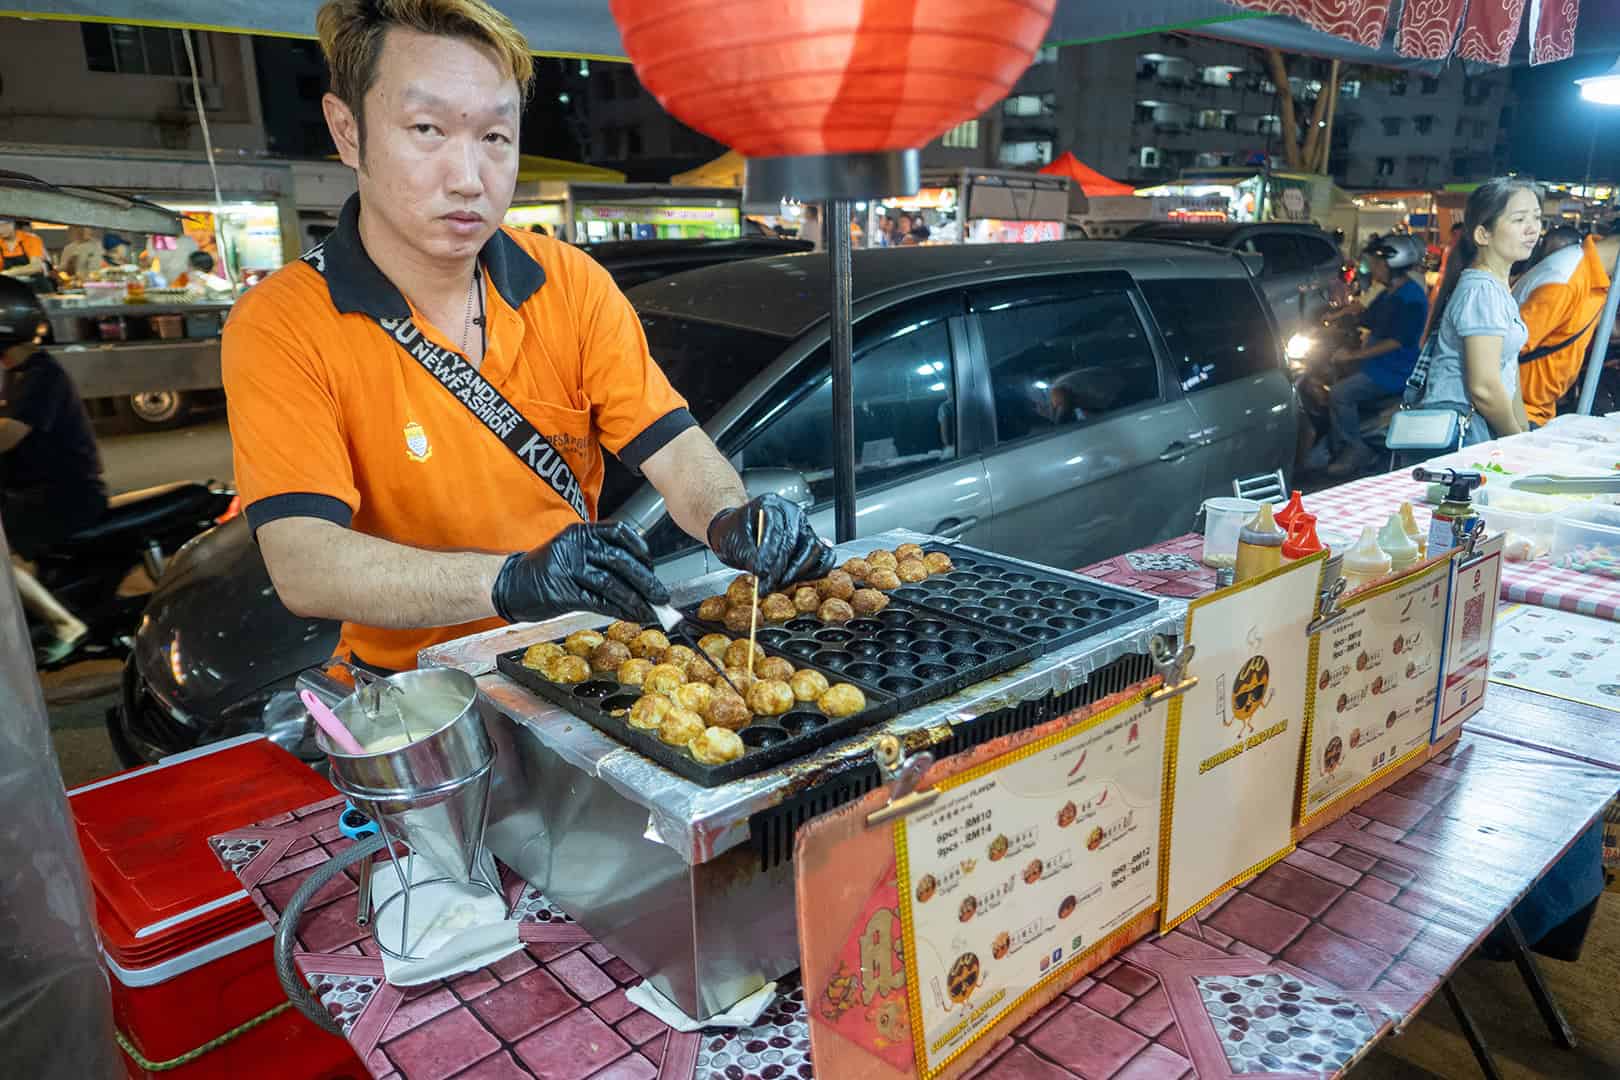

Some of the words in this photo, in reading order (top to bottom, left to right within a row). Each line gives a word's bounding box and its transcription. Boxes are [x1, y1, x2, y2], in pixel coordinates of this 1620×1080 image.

[410, 341, 514, 440] NEWFASHION
[517, 433, 590, 521] KUCHE
[965, 808, 993, 828] RM10
